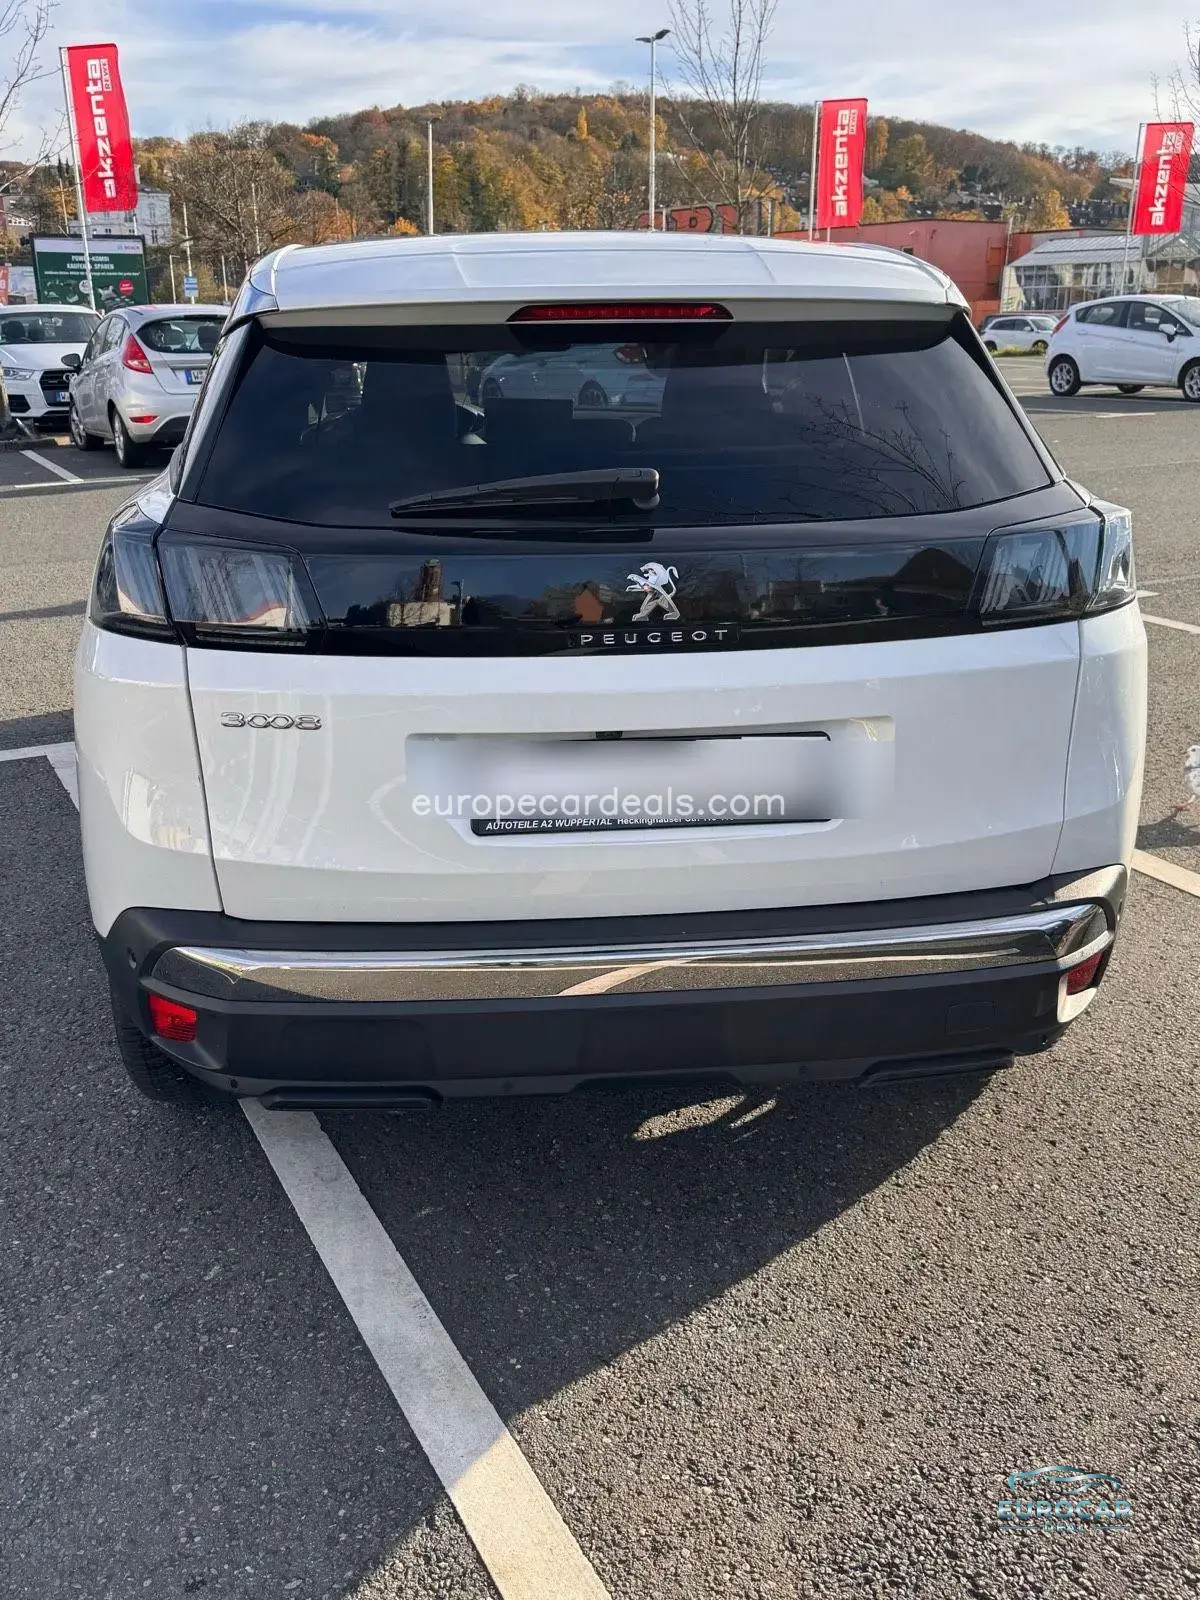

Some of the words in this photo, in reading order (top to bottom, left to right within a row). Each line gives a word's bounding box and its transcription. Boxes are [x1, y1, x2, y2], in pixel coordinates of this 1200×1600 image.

[86, 58, 117, 199] akzenta
[832, 109, 850, 216] akzenta
[1148, 131, 1176, 226] akzenta
[580, 629, 729, 646] PEUGEOT
[220, 711, 322, 730] 3008
[486, 820, 538, 831] AUTOTEILE
[541, 820, 553, 828] A2
[556, 818, 612, 828] WUPPERTAL
